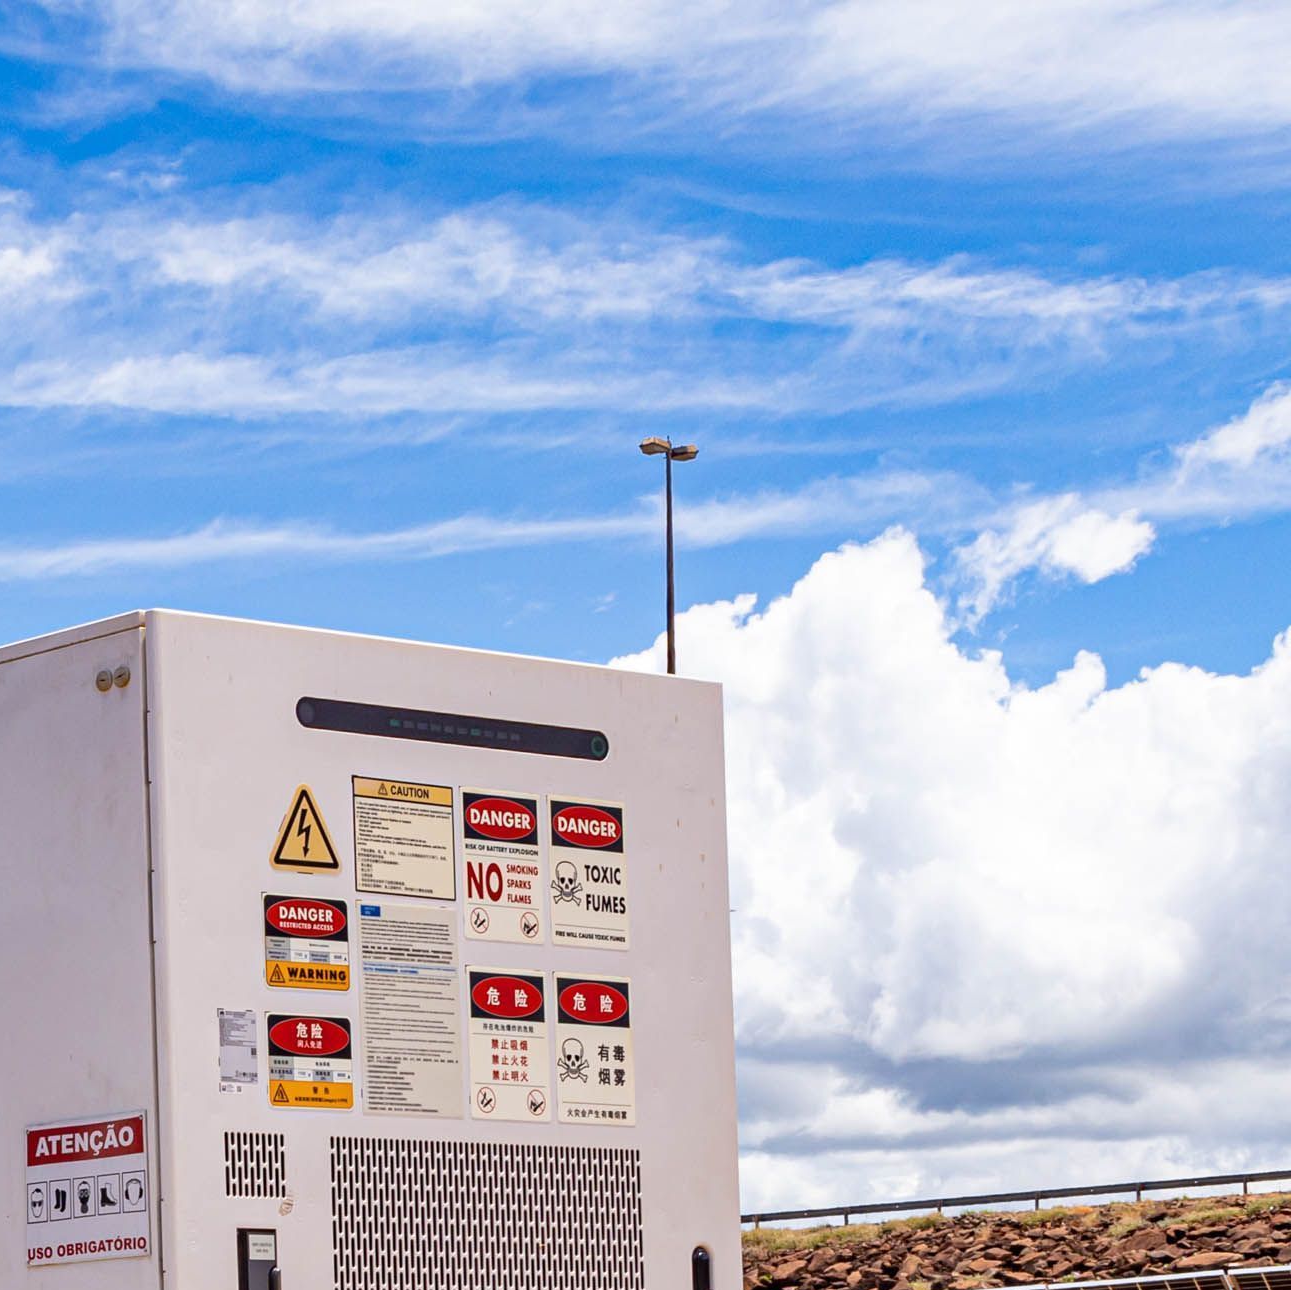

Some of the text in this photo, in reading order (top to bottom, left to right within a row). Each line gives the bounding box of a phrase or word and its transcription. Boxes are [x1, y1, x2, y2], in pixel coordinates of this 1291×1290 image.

[390, 785, 429, 799] CAUTION
[470, 808, 531, 830] DANGER
[557, 816, 617, 838] DANGER
[487, 845, 507, 853] BATTERY
[509, 848, 539, 856] EXPLOSION
[506, 864, 538, 876] SMOKING
[585, 865, 621, 885] TOXIC
[467, 861, 503, 902] NO
[507, 879, 531, 890] SPARKS
[507, 894, 531, 904] FLAMES
[585, 894, 626, 914] FUMES
[279, 906, 333, 923] DANGER
[279, 921, 333, 932] RESTRICTED ACCESS
[287, 967, 346, 981] WARNING
[487, 986, 528, 1008] 危险
[573, 992, 613, 1013] 危险
[296, 1023, 323, 1039] 危险
[491, 1039, 528, 1050] 禁止吸烟
[597, 1044, 625, 1062] 有毒
[492, 1055, 528, 1067] 禁止火花
[598, 1068, 626, 1086] 烟雾
[35, 1124, 134, 1157] ATENÇÃO
[27, 1236, 147, 1260] USO OBRIGATÓRIO
